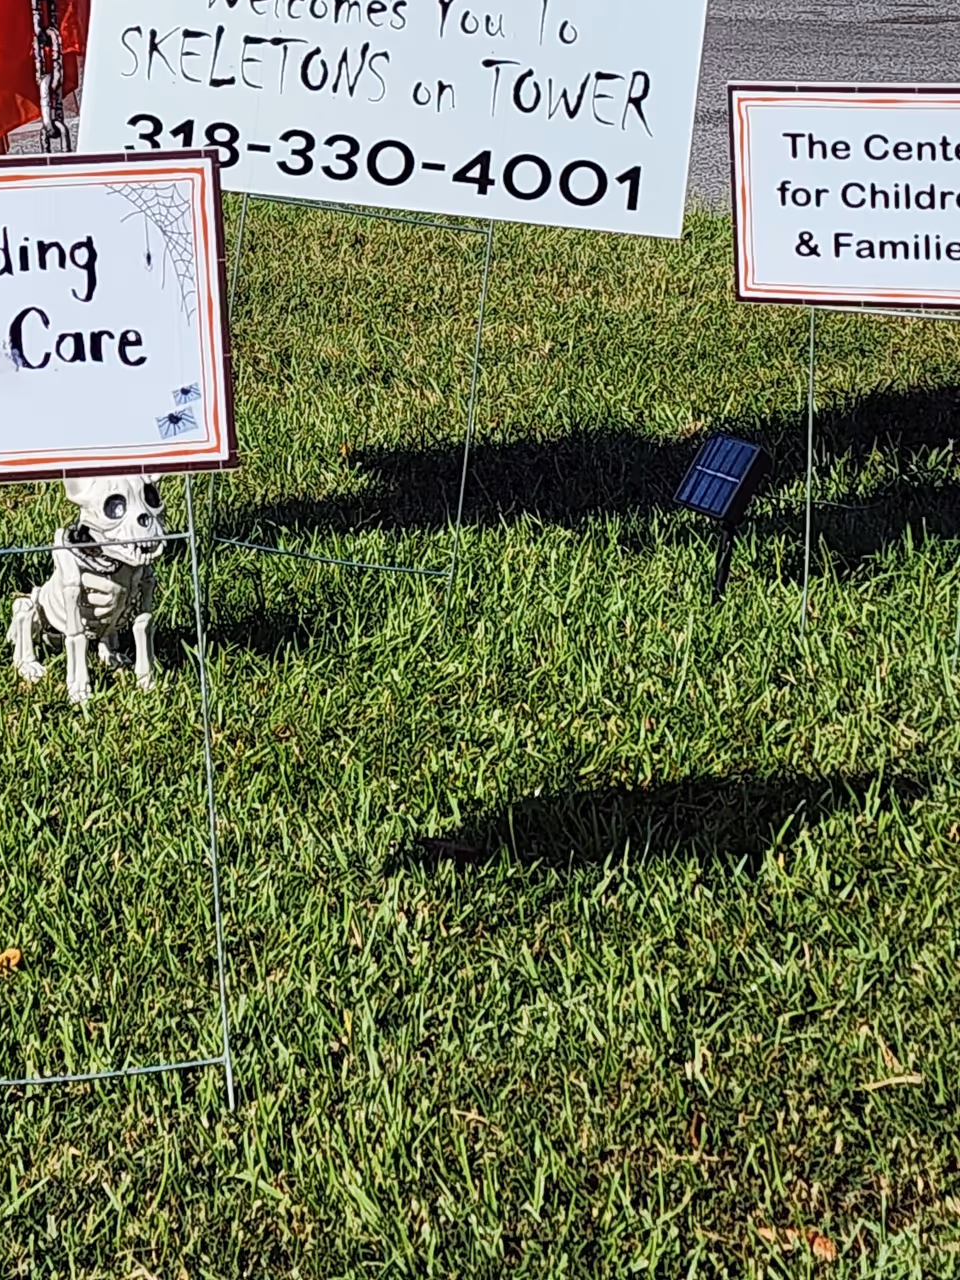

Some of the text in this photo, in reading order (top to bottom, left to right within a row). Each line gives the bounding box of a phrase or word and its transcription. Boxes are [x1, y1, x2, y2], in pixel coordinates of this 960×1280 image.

[121, 24, 653, 138] SKELETONS on TOWER
[123, 113, 642, 211] 318-330-4001
[782, 132, 960, 162] The Cent
[776, 180, 960, 210] for Childr
[794, 230, 821, 258] &
[9, 306, 148, 370] Care
